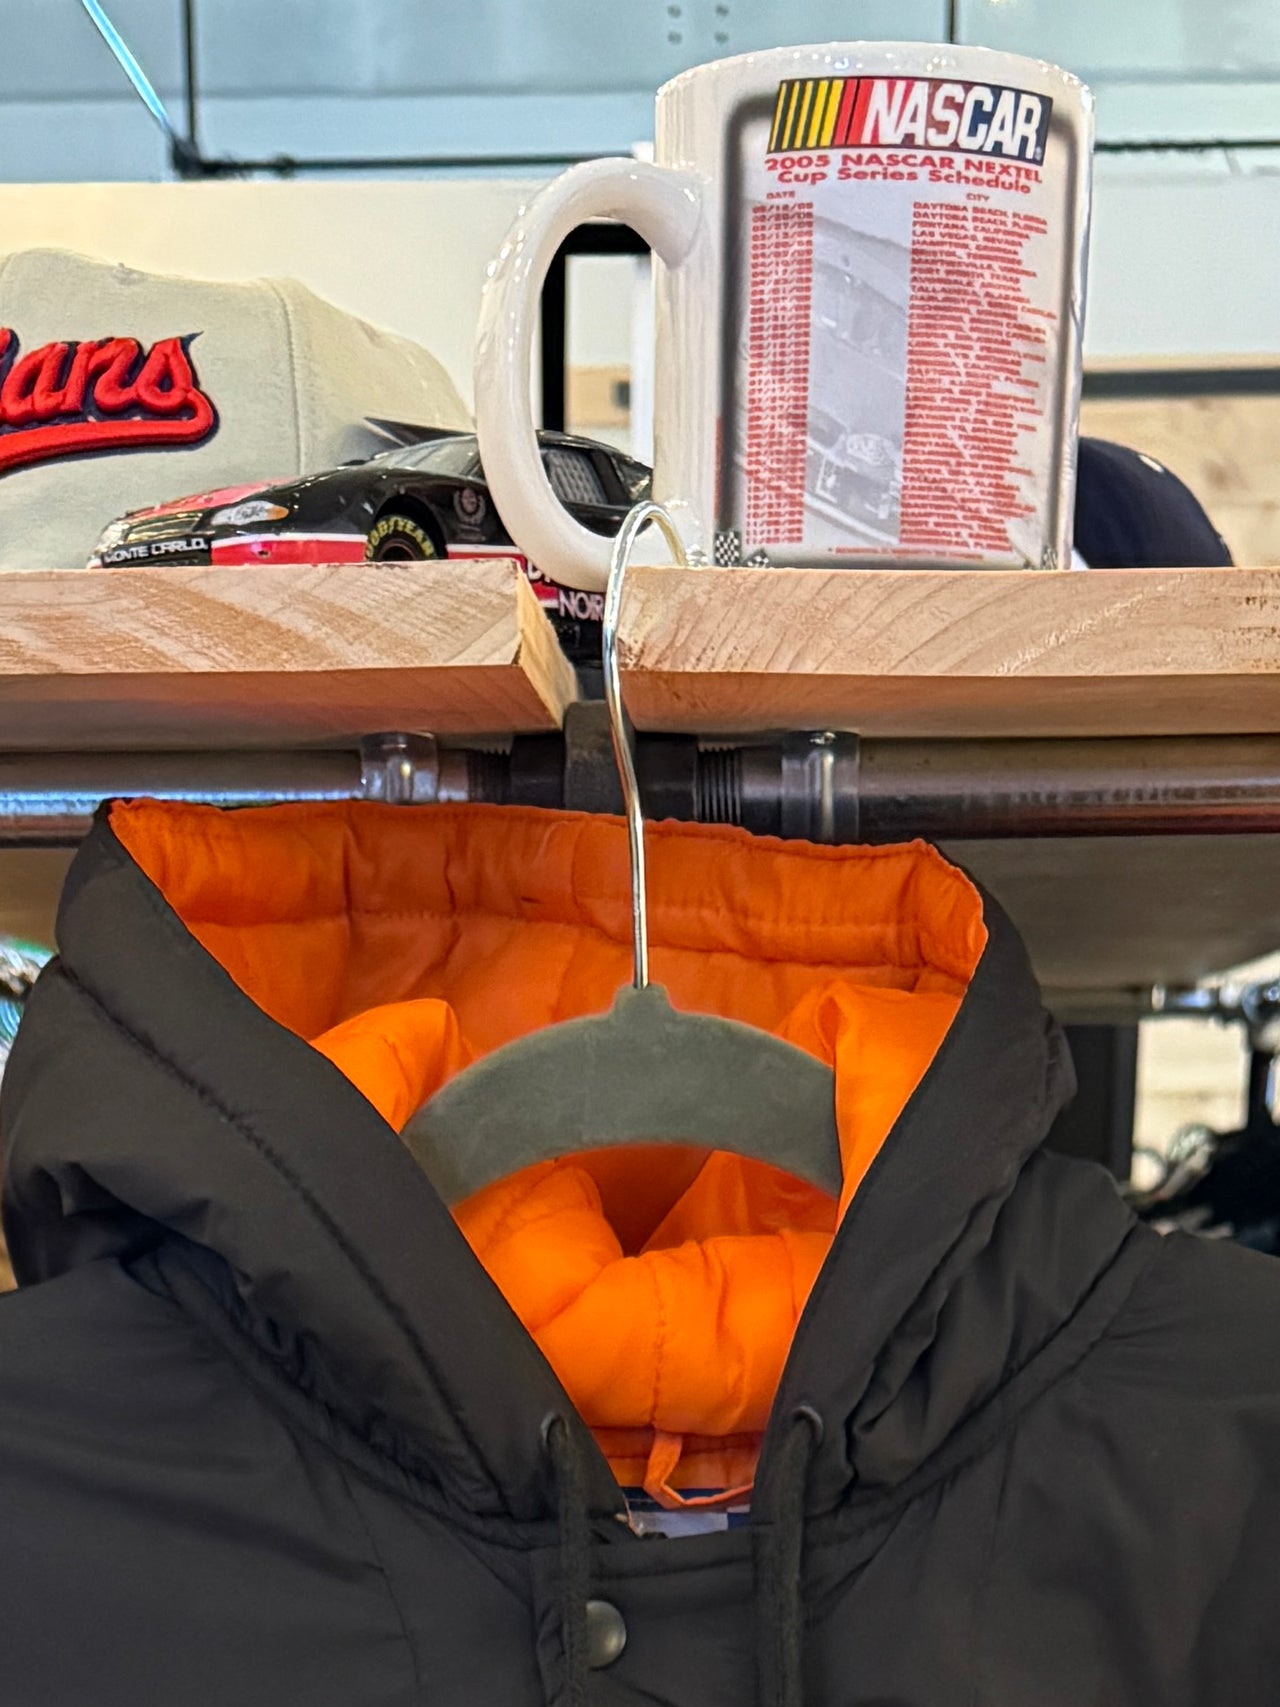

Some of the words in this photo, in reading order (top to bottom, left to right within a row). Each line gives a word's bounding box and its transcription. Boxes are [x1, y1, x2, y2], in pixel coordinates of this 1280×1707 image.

[861, 79, 1042, 159] NASCAR
[764, 155, 830, 171] 2005
[841, 153, 954, 169] NASCAR
[964, 157, 1043, 183] NEXTEL
[778, 170, 828, 185] Cup
[837, 168, 918, 181] Series
[929, 168, 1031, 194] Schedule
[366, 515, 434, 558] OODYEAR
[104, 545, 149, 563] MONTE
